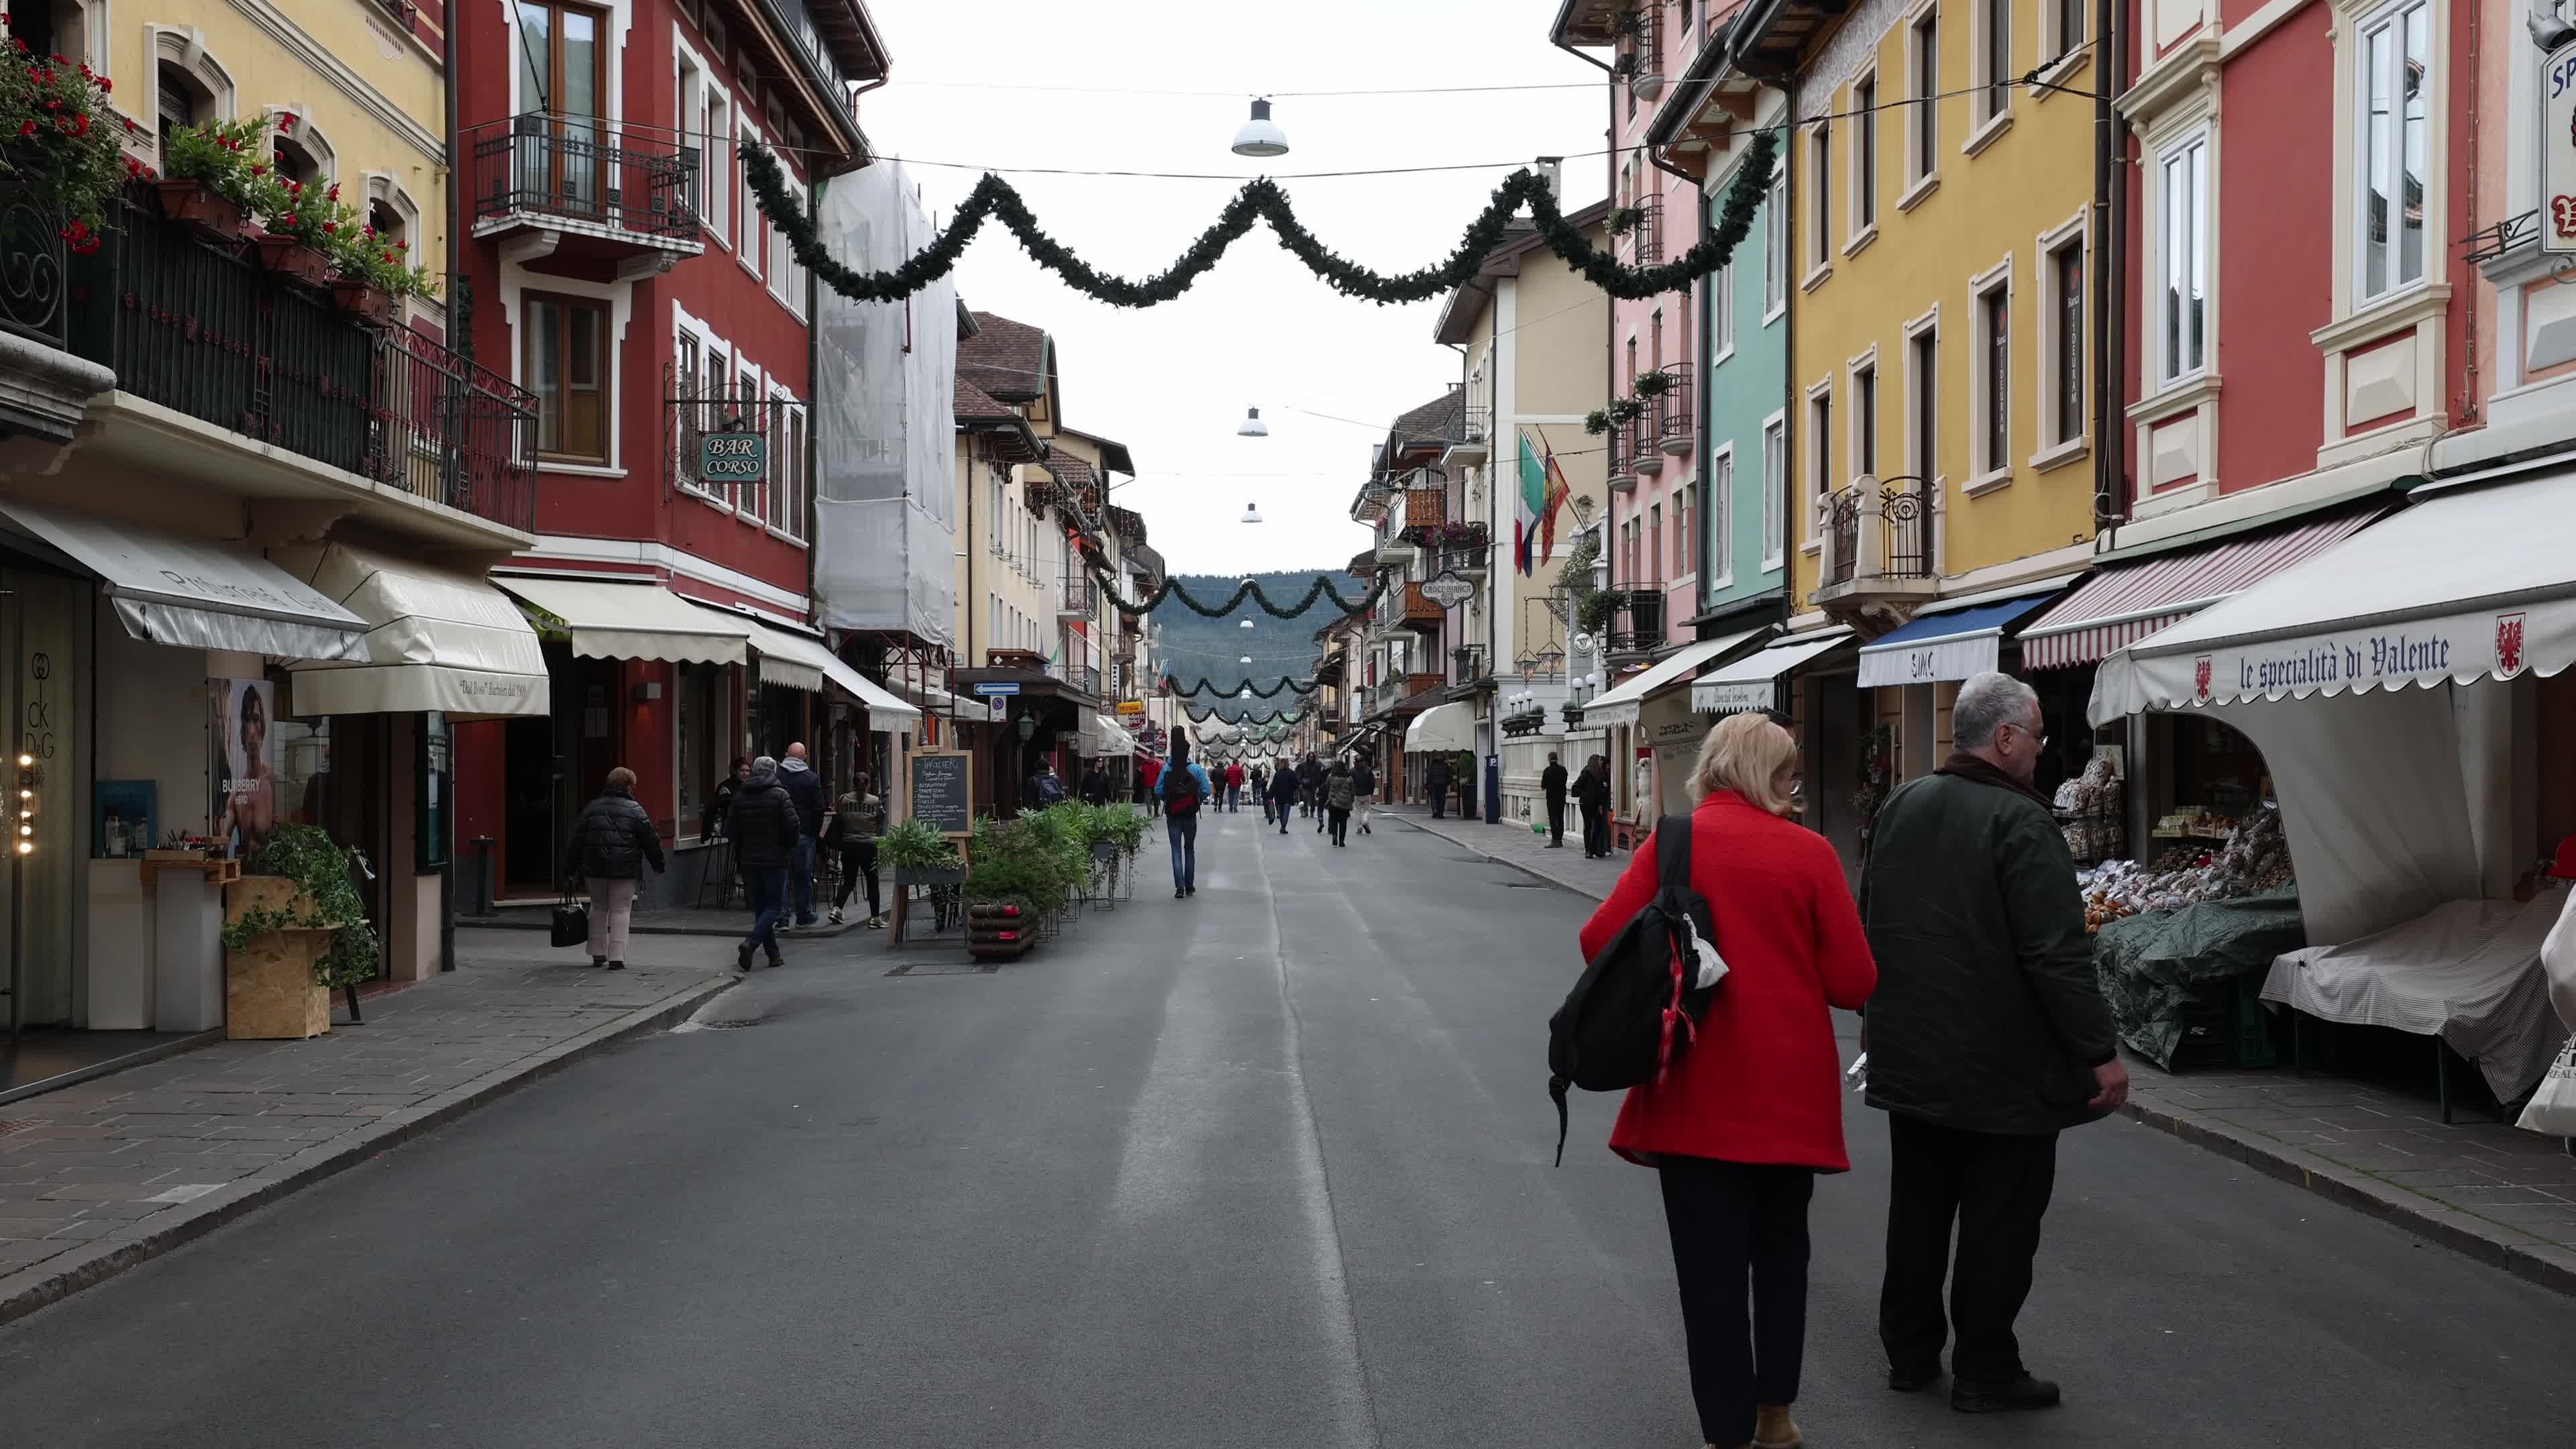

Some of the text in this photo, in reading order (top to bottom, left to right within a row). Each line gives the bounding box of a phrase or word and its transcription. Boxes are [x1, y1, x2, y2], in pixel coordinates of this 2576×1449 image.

[708, 439, 757, 458] BAR
[706, 460, 759, 475] CORSO
[2241, 634, 2449, 694] le specialità di Valente
[222, 778, 261, 794] BURBERRY
[235, 795, 248, 805] HERO
